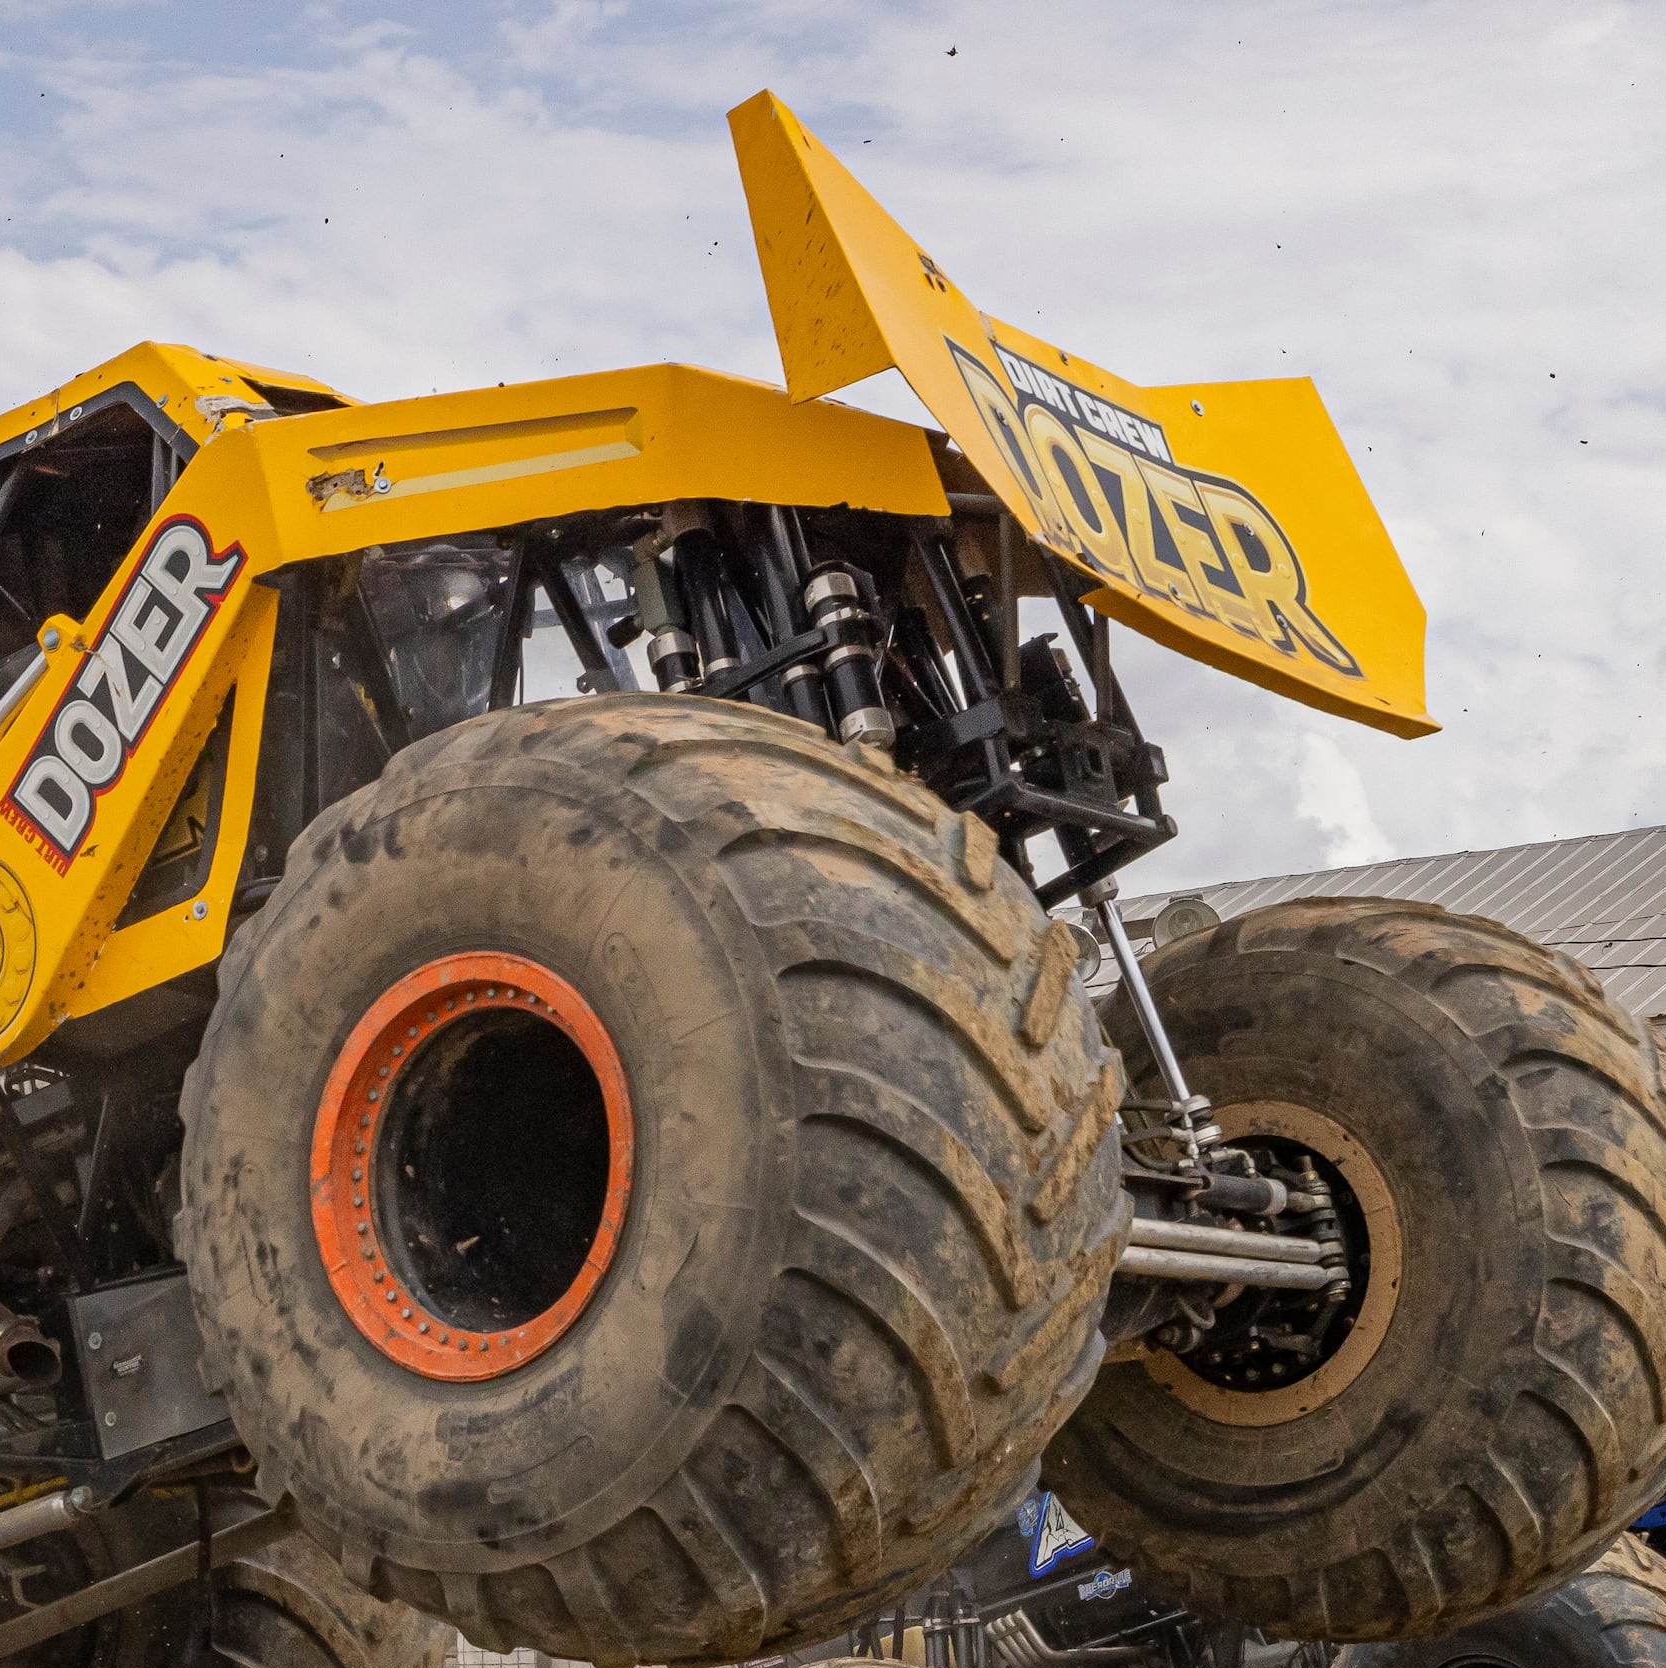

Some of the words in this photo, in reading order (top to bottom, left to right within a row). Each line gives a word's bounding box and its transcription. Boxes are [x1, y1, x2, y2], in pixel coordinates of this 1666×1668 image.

[948, 343, 1353, 670] DOZER
[996, 346, 1079, 421] DIRT
[1073, 389, 1172, 464] CREW
[14, 525, 239, 852] DOZER
[35, 841, 69, 879] DIRT
